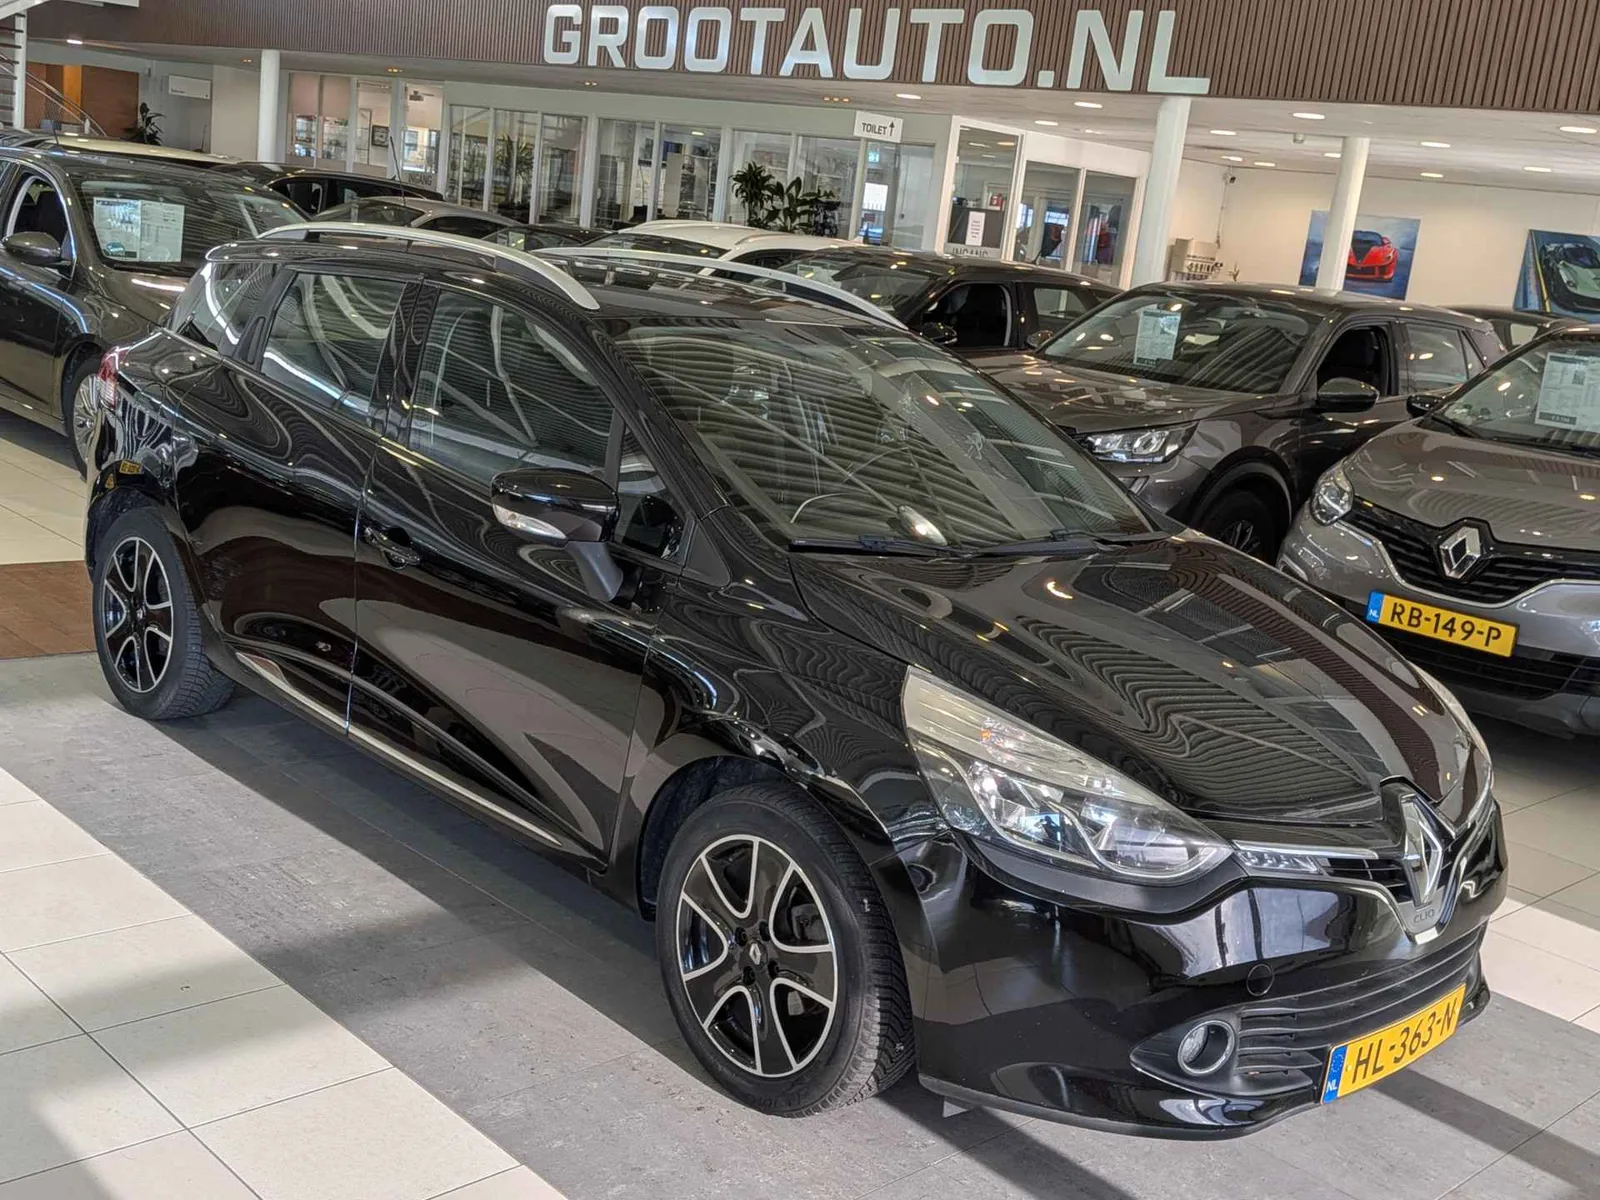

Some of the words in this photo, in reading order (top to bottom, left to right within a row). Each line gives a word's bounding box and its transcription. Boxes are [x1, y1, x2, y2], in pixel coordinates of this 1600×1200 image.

[543, 4, 1211, 94] GROOTAUTO.NL
[861, 122, 887, 135] TOILET
[1368, 609, 1379, 618] NL
[1390, 602, 1502, 647] RB-149-P
[1413, 909, 1435, 923] CLIO
[1325, 1079, 1338, 1093] NL
[1351, 997, 1458, 1084] HL-363-N
